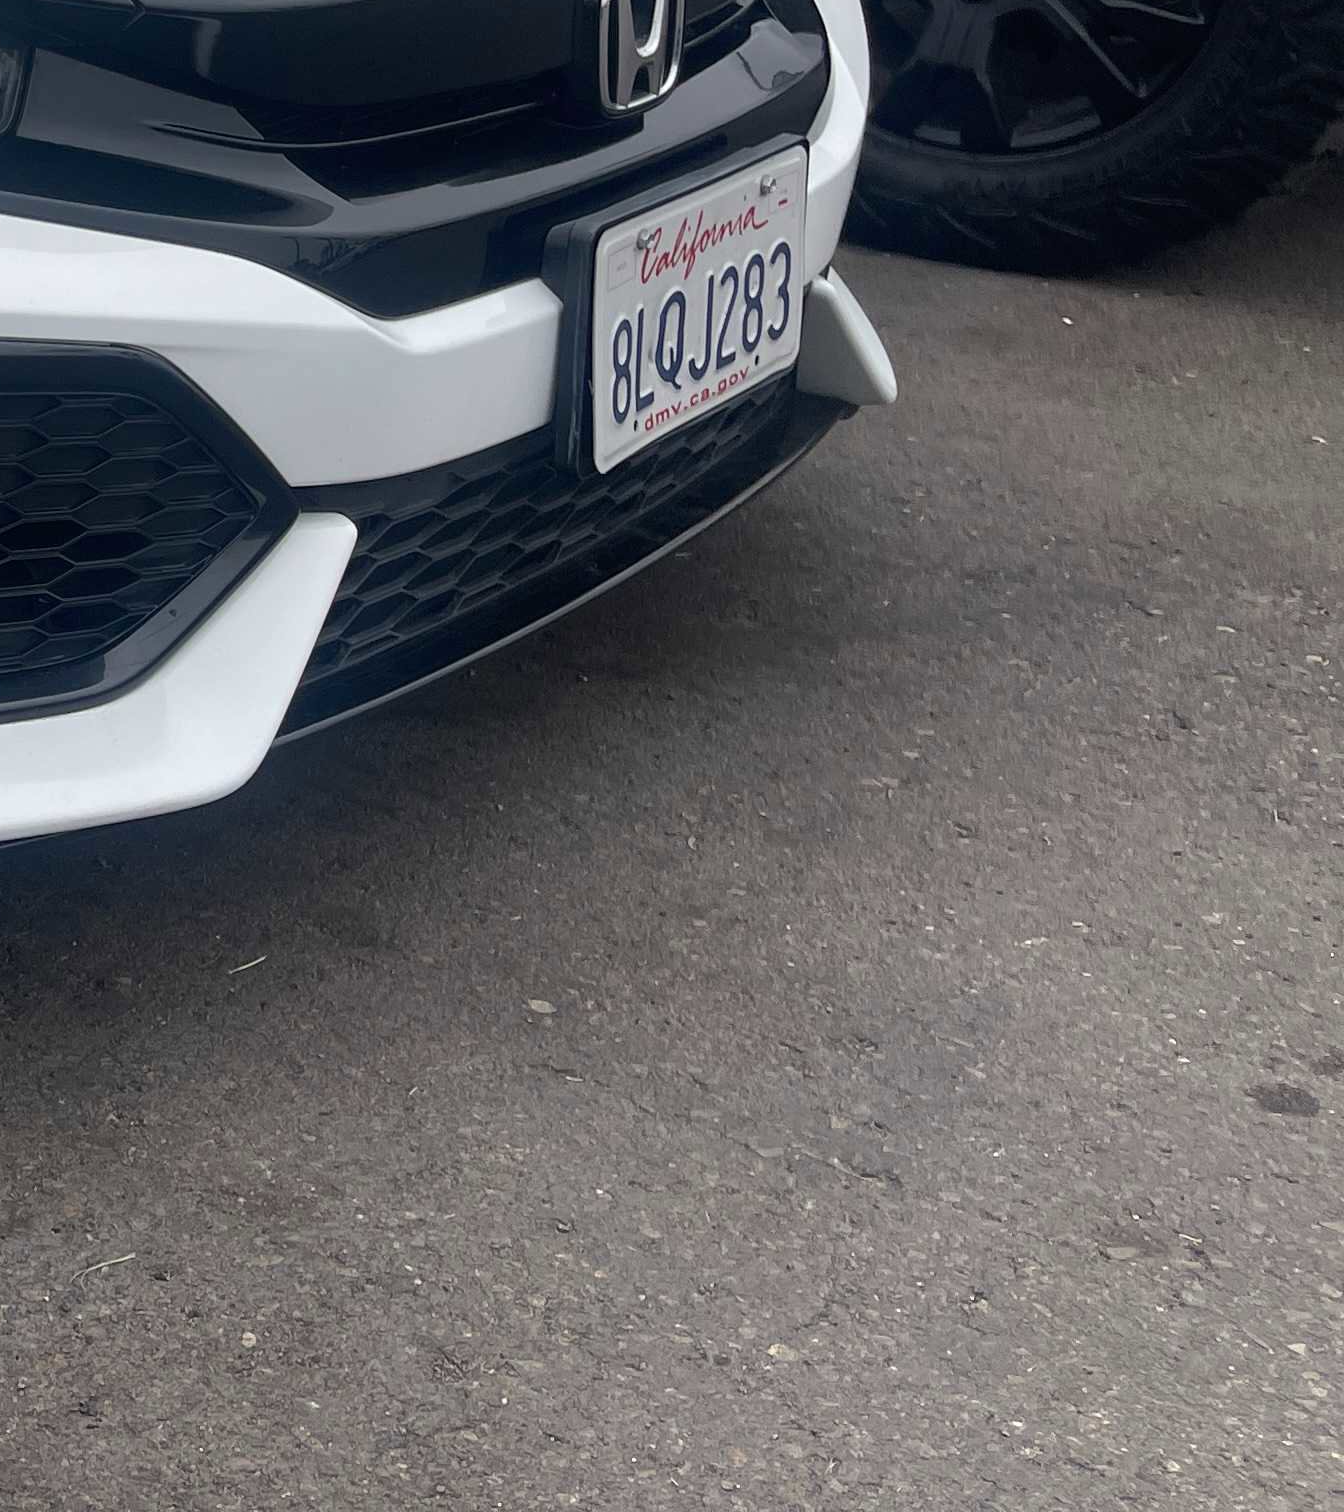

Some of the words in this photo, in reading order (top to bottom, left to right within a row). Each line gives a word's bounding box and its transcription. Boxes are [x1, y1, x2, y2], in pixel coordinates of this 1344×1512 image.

[641, 205, 769, 285] California
[612, 240, 792, 425] 8LQJ283
[644, 365, 751, 432] dmv.ca.gov
